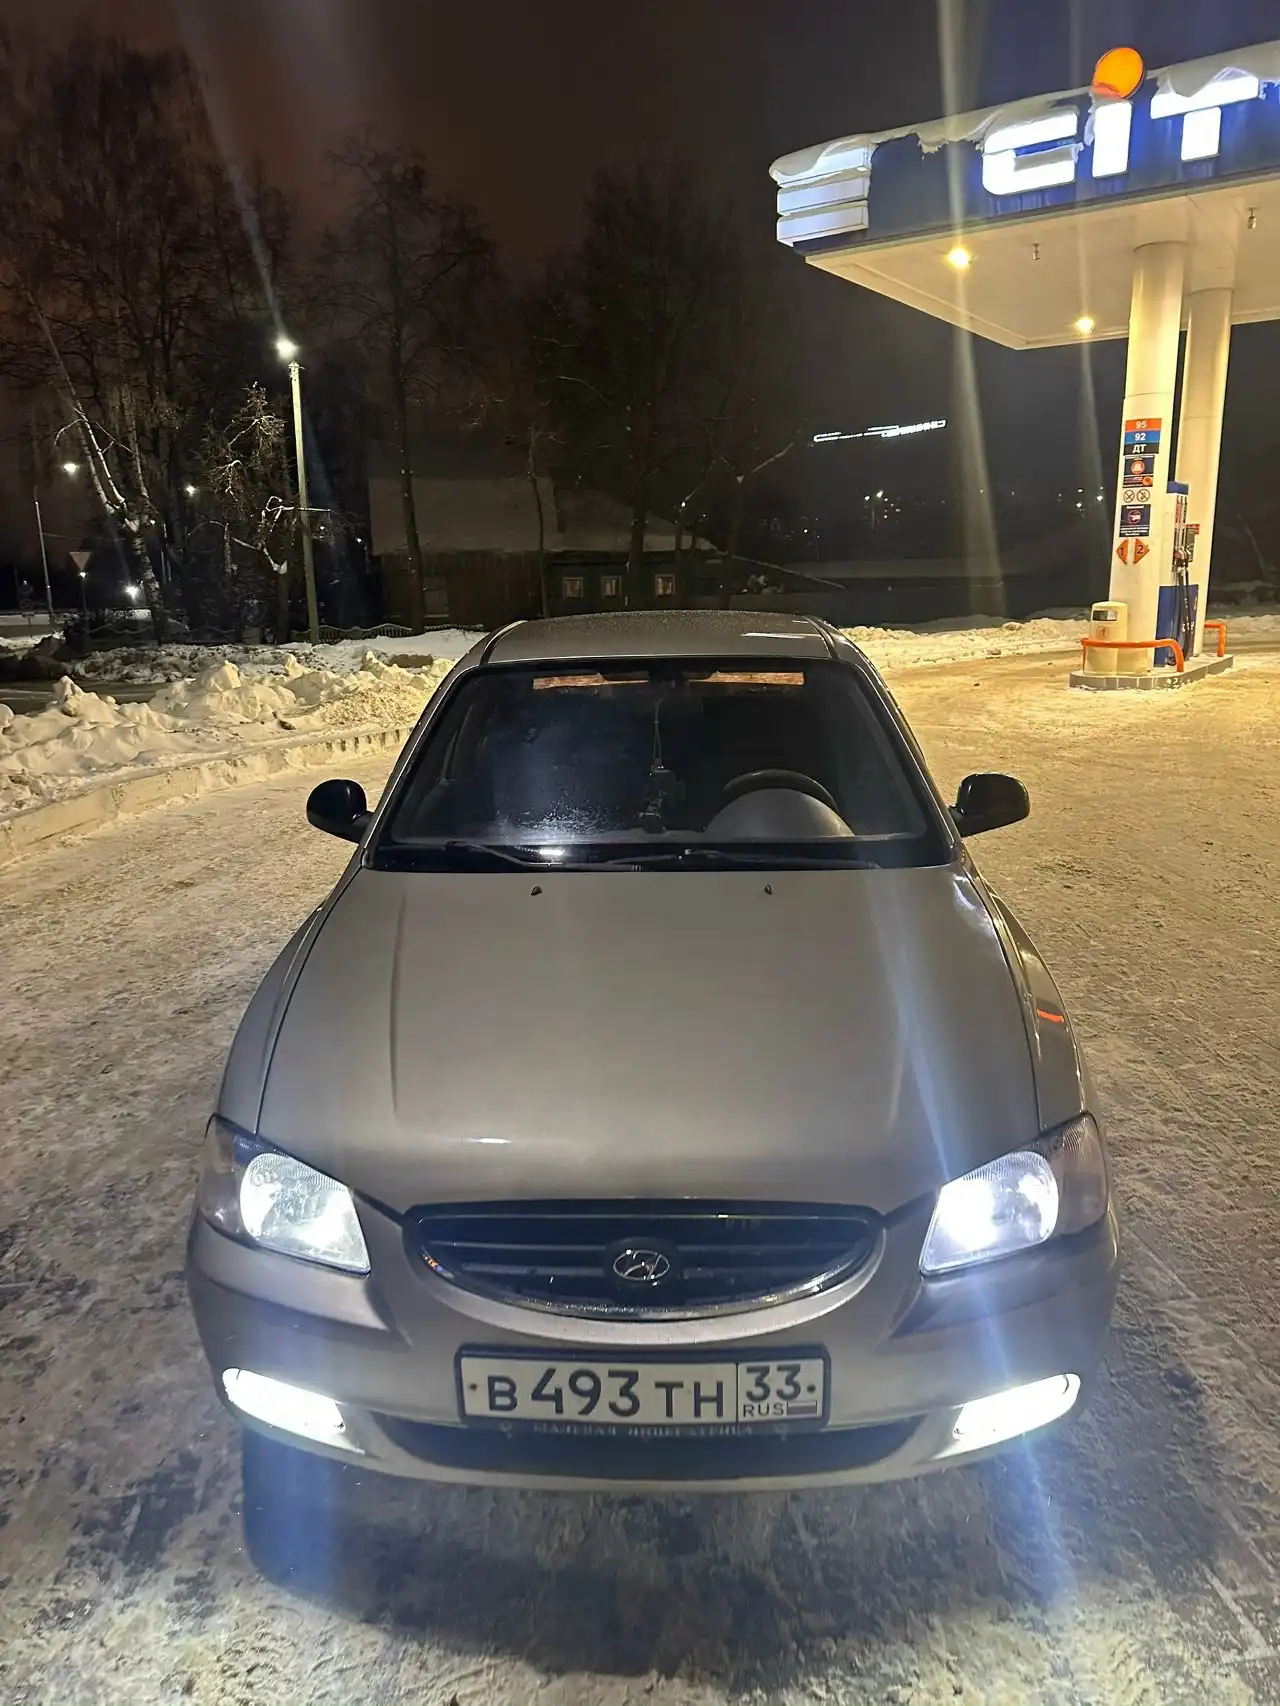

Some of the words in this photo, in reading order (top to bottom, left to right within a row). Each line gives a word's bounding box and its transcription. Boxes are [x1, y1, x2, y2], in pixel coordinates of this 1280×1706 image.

[1135, 420, 1148, 429] 95
[1134, 432, 1146, 441] 92
[1132, 444, 1147, 453] ДТ
[1136, 544, 1144, 554] 2
[745, 1363, 802, 1401] 33
[531, 1367, 641, 1417] 493
[742, 1402, 785, 1417] RUS
